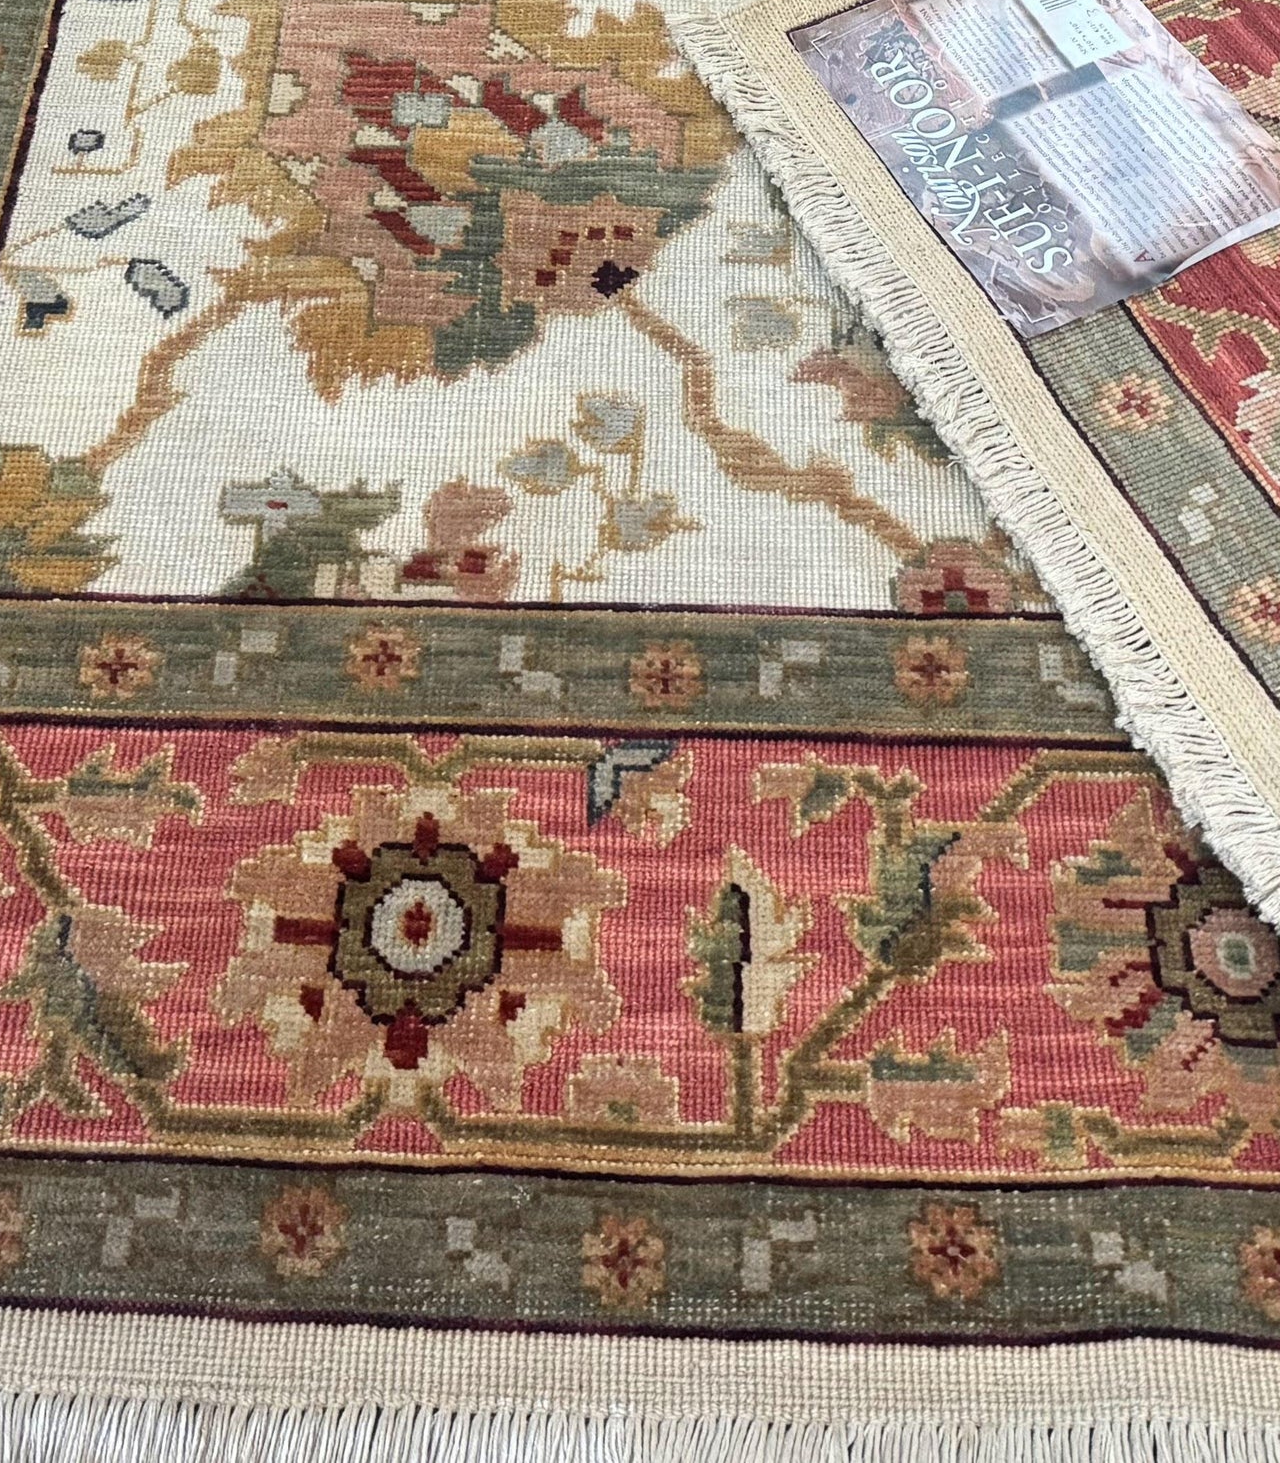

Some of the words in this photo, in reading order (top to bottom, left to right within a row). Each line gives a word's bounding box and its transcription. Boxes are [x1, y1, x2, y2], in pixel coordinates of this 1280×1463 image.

[870, 49, 1073, 275] SUF-I-NOOR
[891, 129, 1001, 246] Nourison
[915, 59, 1069, 234] COLLECTION
